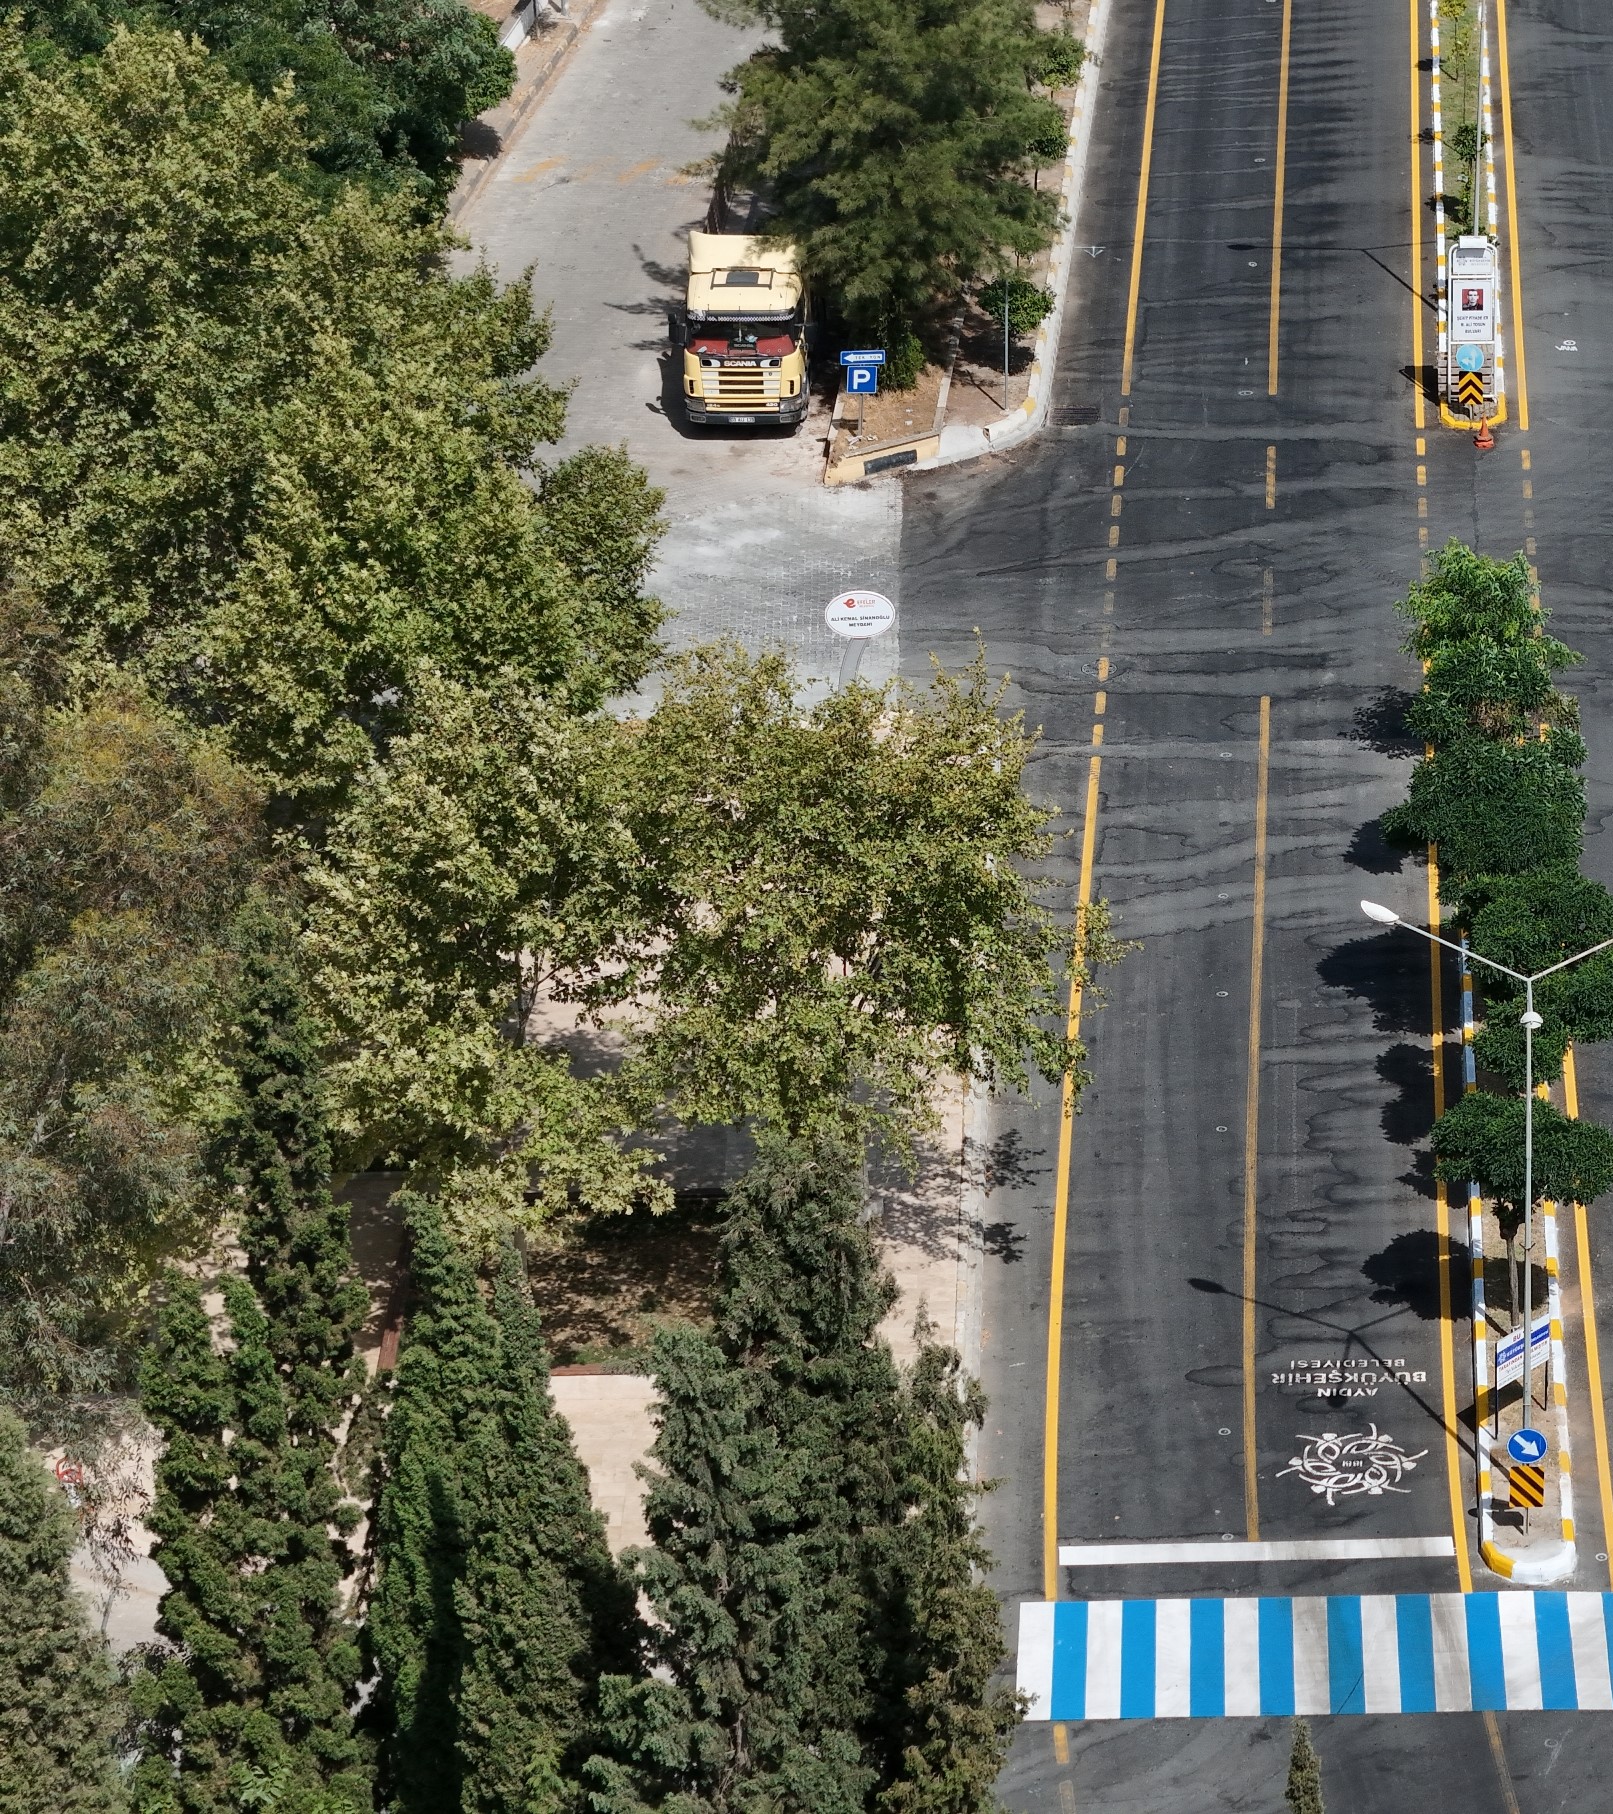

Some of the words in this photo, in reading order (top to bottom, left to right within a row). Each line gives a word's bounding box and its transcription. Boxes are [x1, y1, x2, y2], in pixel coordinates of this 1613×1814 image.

[852, 369, 871, 390] P
[1271, 1369, 1427, 1386] BÜYÜKŞEHİR
[1317, 1387, 1379, 1397] AYDIN
